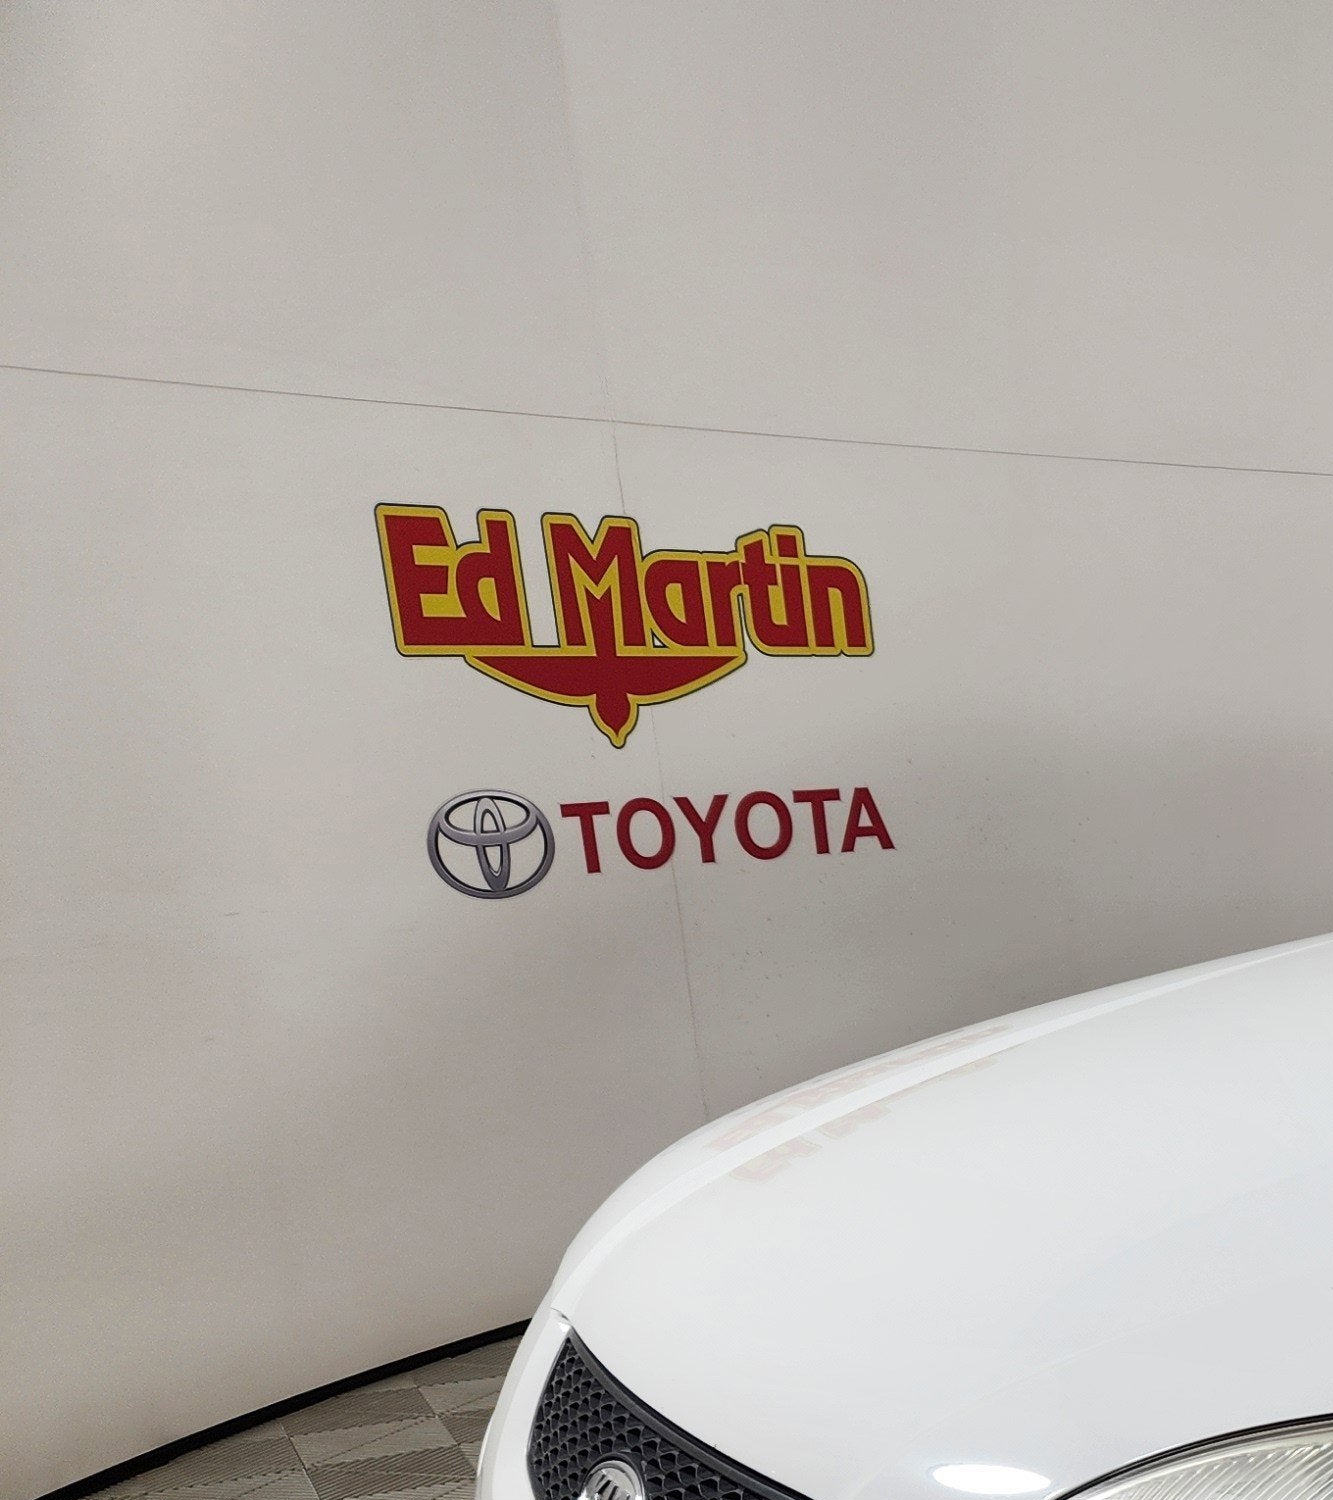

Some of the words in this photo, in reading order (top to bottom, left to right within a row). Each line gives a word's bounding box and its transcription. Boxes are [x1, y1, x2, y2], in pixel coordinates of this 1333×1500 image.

[379, 507, 529, 651] Ed
[543, 514, 871, 653] Martin
[560, 786, 895, 874] TOYOTA
